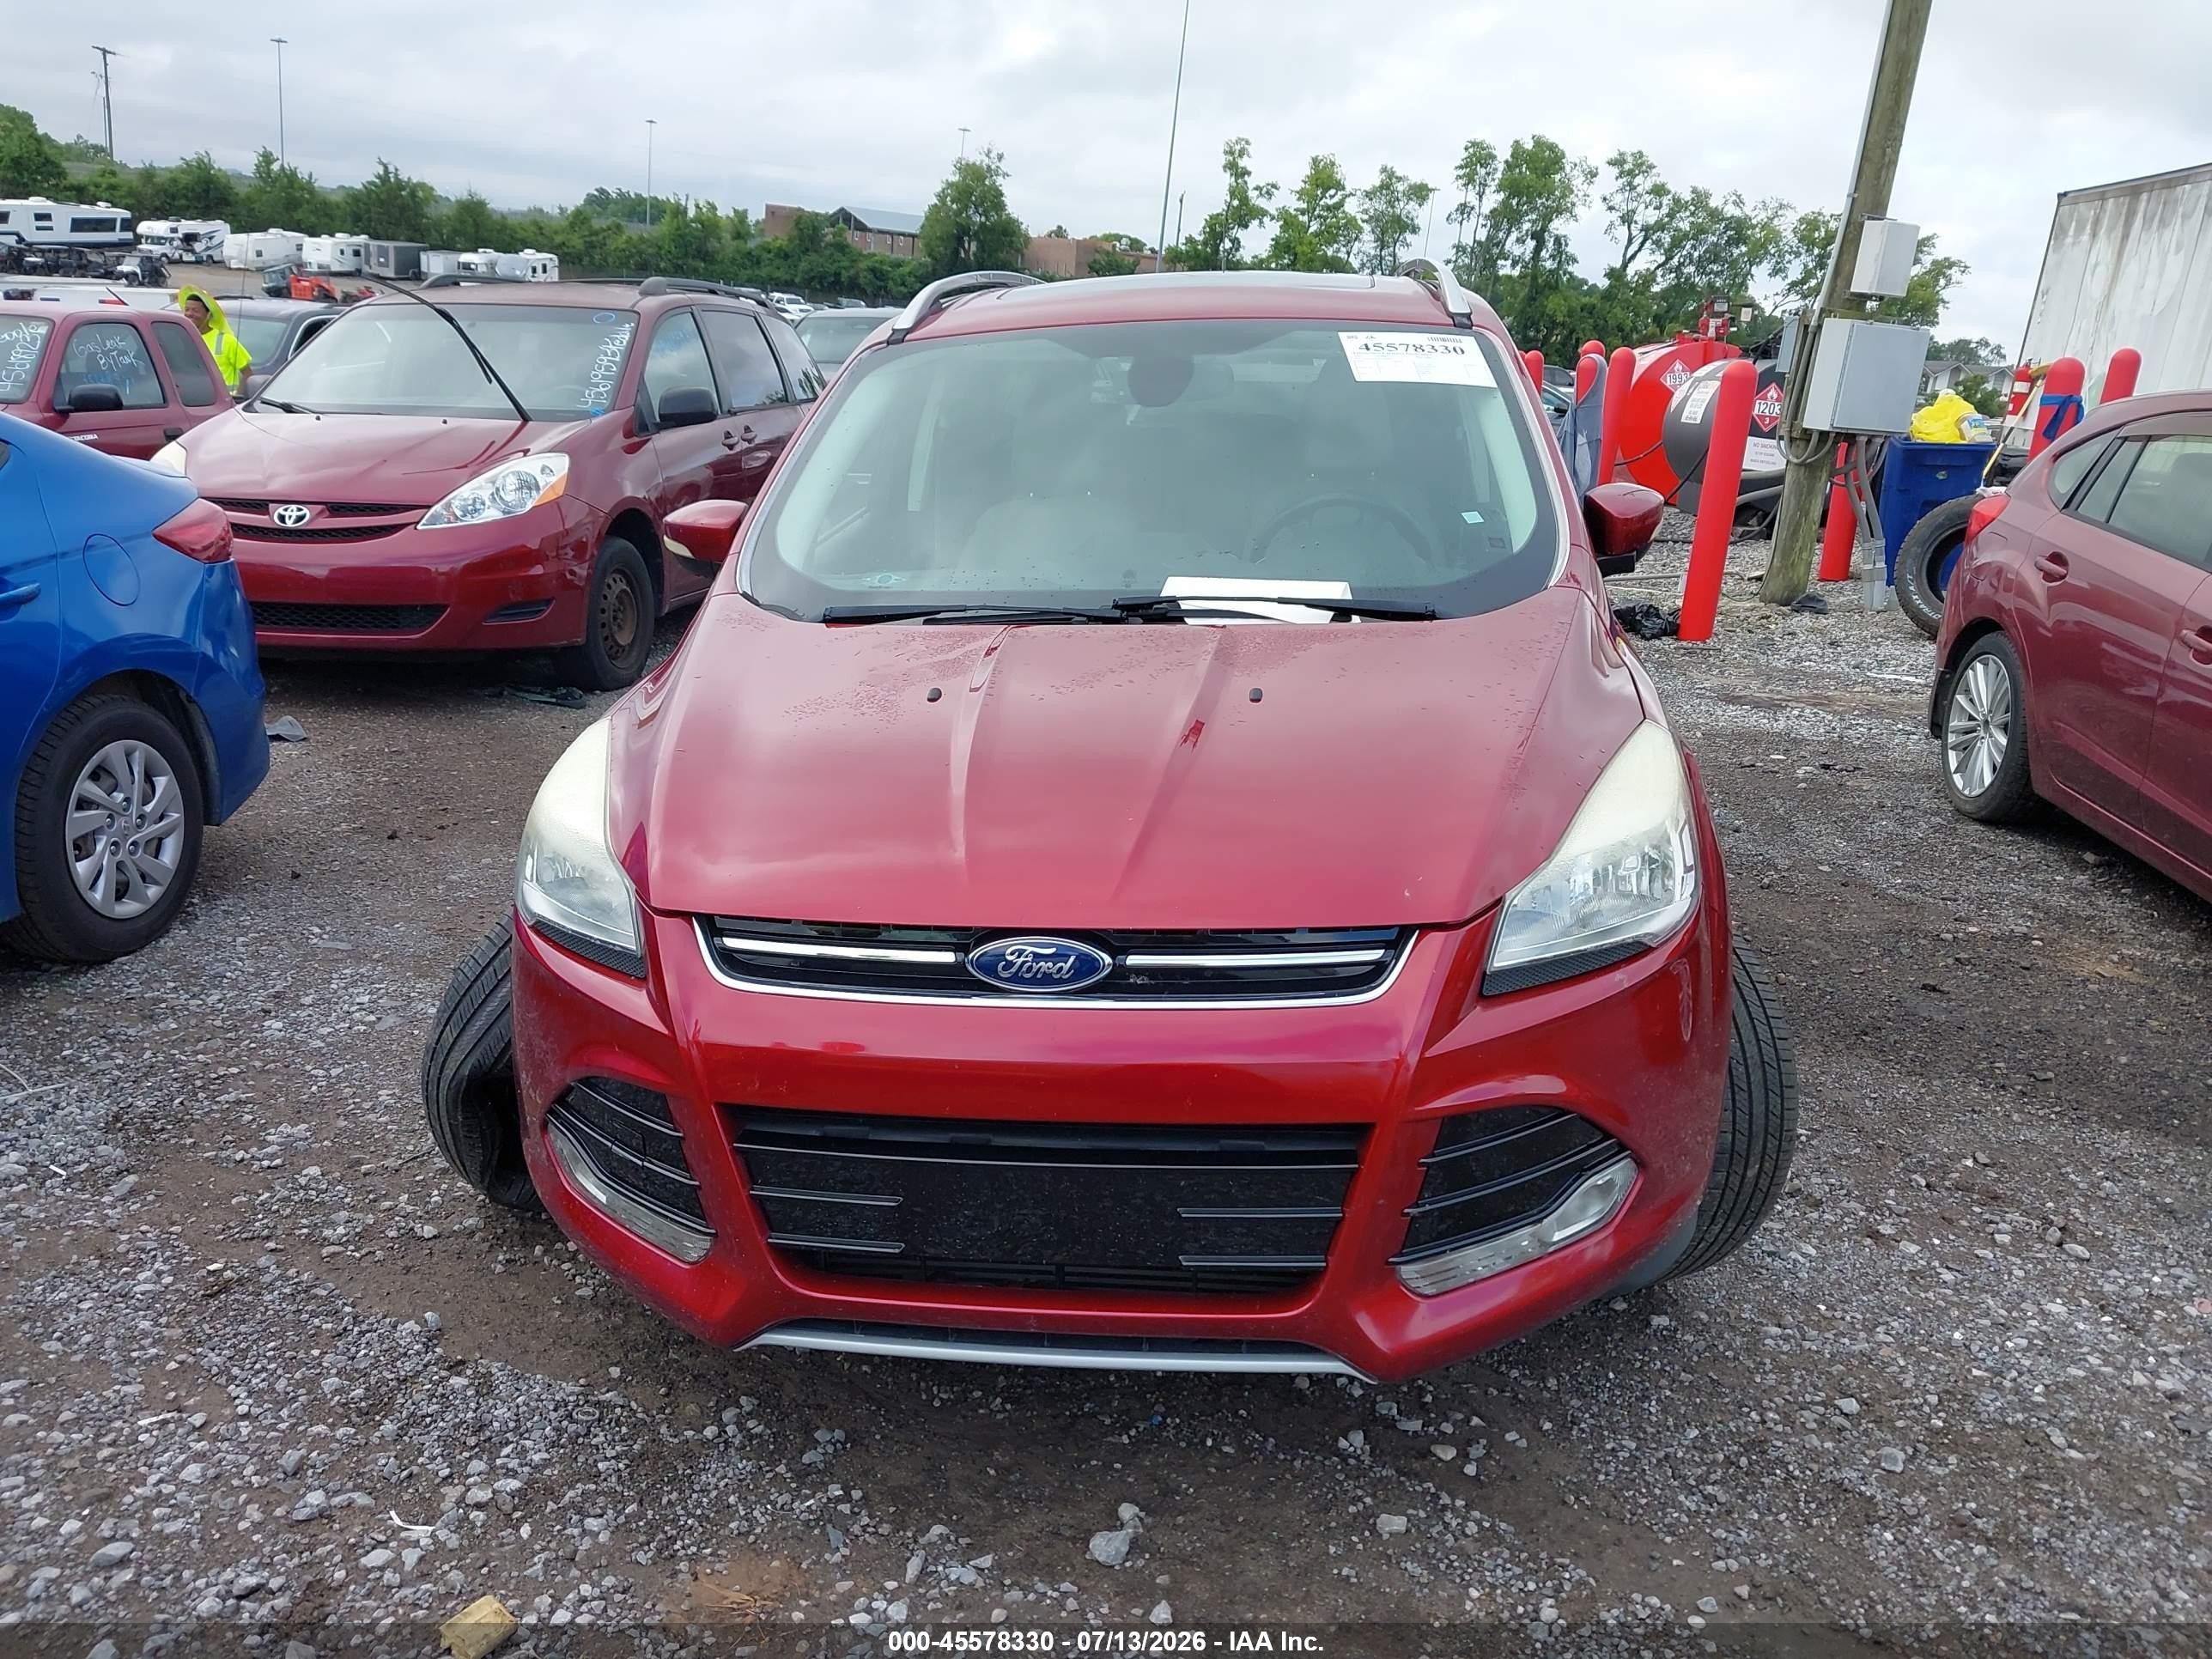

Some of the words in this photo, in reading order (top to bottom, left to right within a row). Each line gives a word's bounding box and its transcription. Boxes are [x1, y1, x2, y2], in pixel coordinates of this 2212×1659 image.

[1358, 343, 1465, 356] 45578330
[1668, 373, 1689, 385] 1993
[1757, 401, 1783, 416] 1203
[997, 945, 1077, 979] Ford
